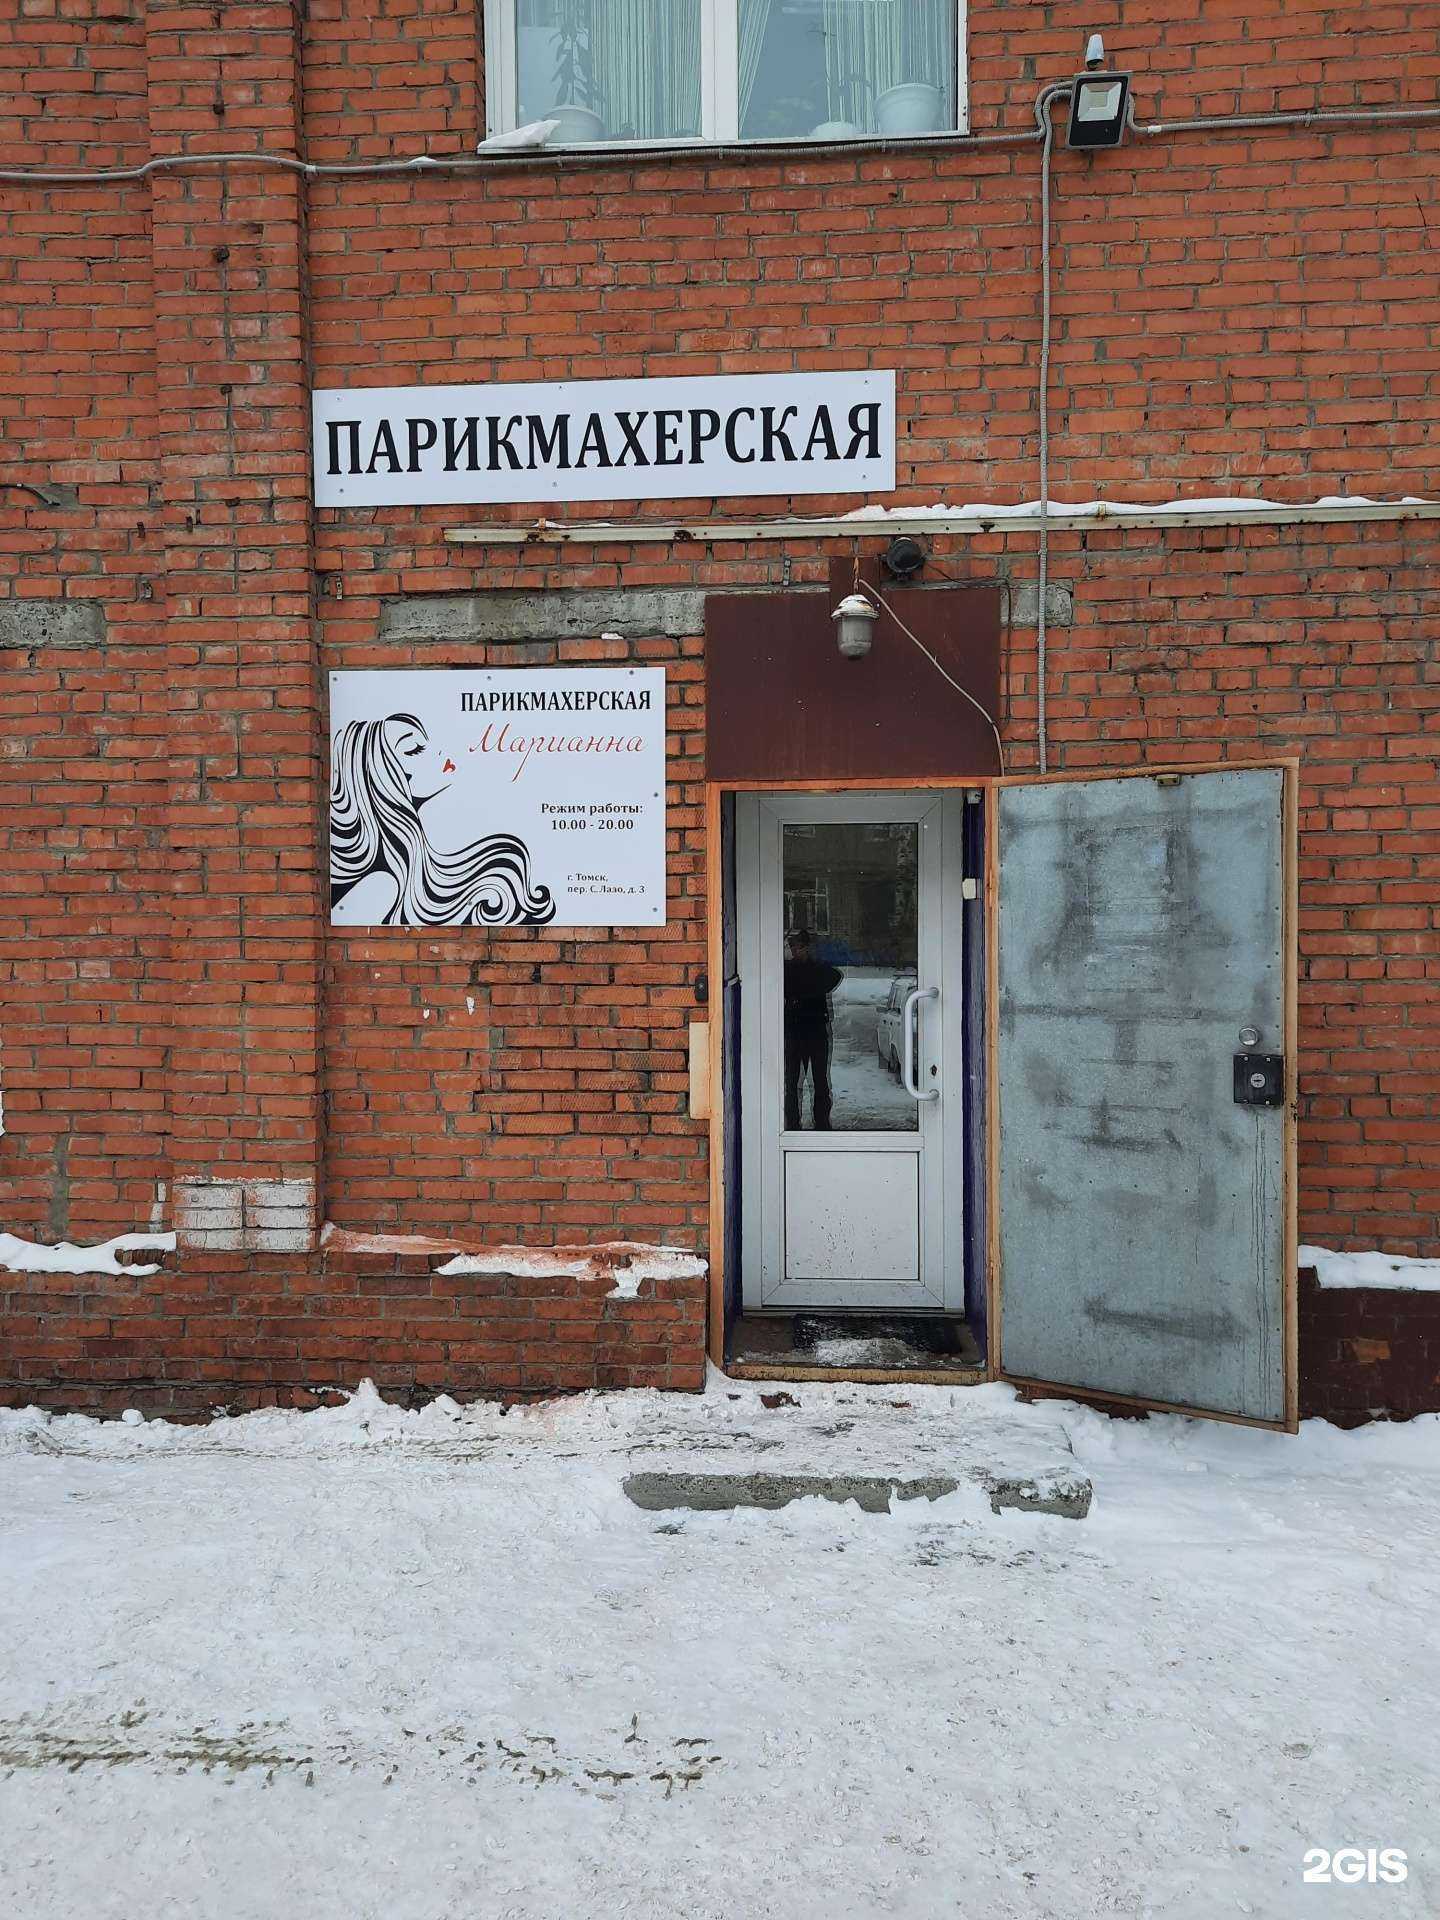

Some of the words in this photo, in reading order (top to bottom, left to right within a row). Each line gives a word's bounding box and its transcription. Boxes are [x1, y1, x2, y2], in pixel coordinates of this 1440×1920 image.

[325, 402, 882, 475] ПАРИКМАХЕРСКАЯ
[460, 690, 651, 711] ПАРИКМАХЕРСКАЯ
[469, 722, 644, 782] Марианна
[541, 803, 586, 814] Режим
[589, 803, 644, 816] работы:
[551, 819, 587, 830] 10.00
[598, 819, 634, 830] 20.00
[576, 873, 608, 882] Томск,
[567, 885, 588, 895] пер.
[627, 886, 637, 894] д.
[638, 885, 645, 894] 3
